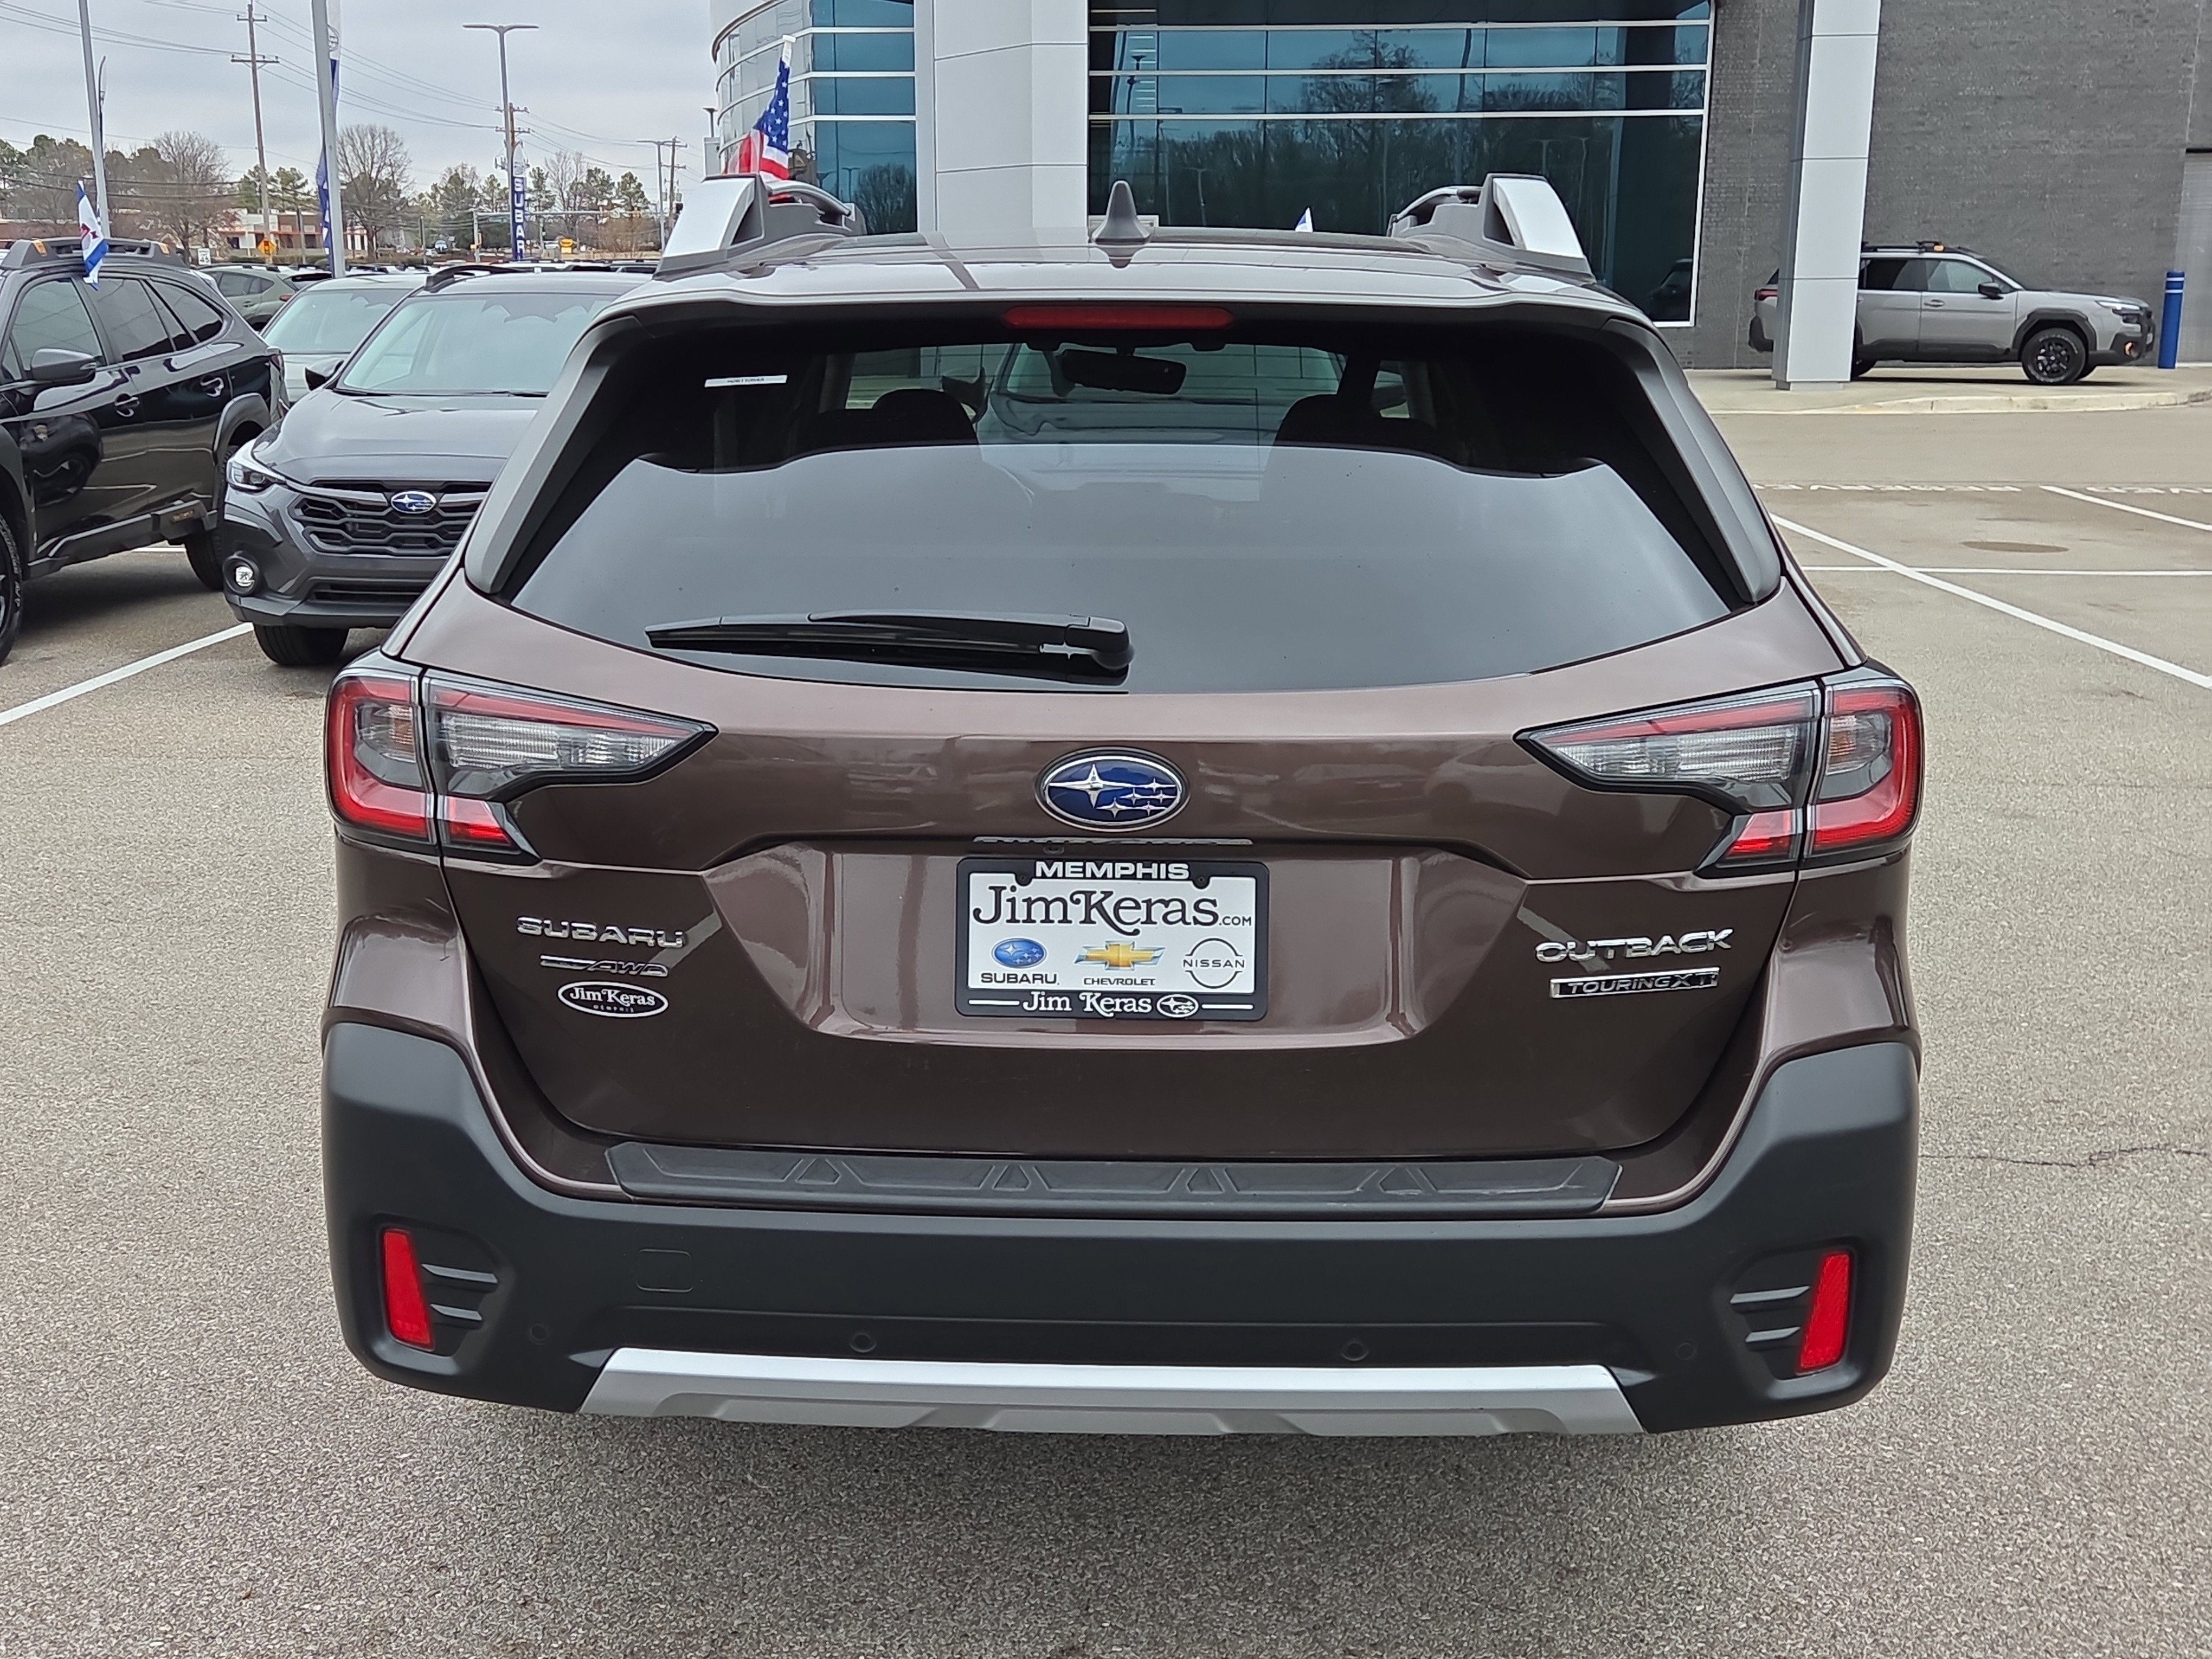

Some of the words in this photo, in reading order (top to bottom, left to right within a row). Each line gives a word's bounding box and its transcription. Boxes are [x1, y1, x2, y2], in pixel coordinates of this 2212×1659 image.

[514, 178, 524, 259] SUBAR
[1036, 861, 1190, 879] MEMPHIS
[517, 916, 684, 948] SUBARU
[1536, 929, 1733, 962] OUTBACK
[587, 960, 669, 977] AWD
[1183, 959, 1245, 968] NISSAN
[1083, 978, 1155, 986] CHEVROLET
[1568, 976, 1671, 994] TOURING
[1023, 991, 1072, 1012] Jim
[1079, 993, 1153, 1017] Keras
